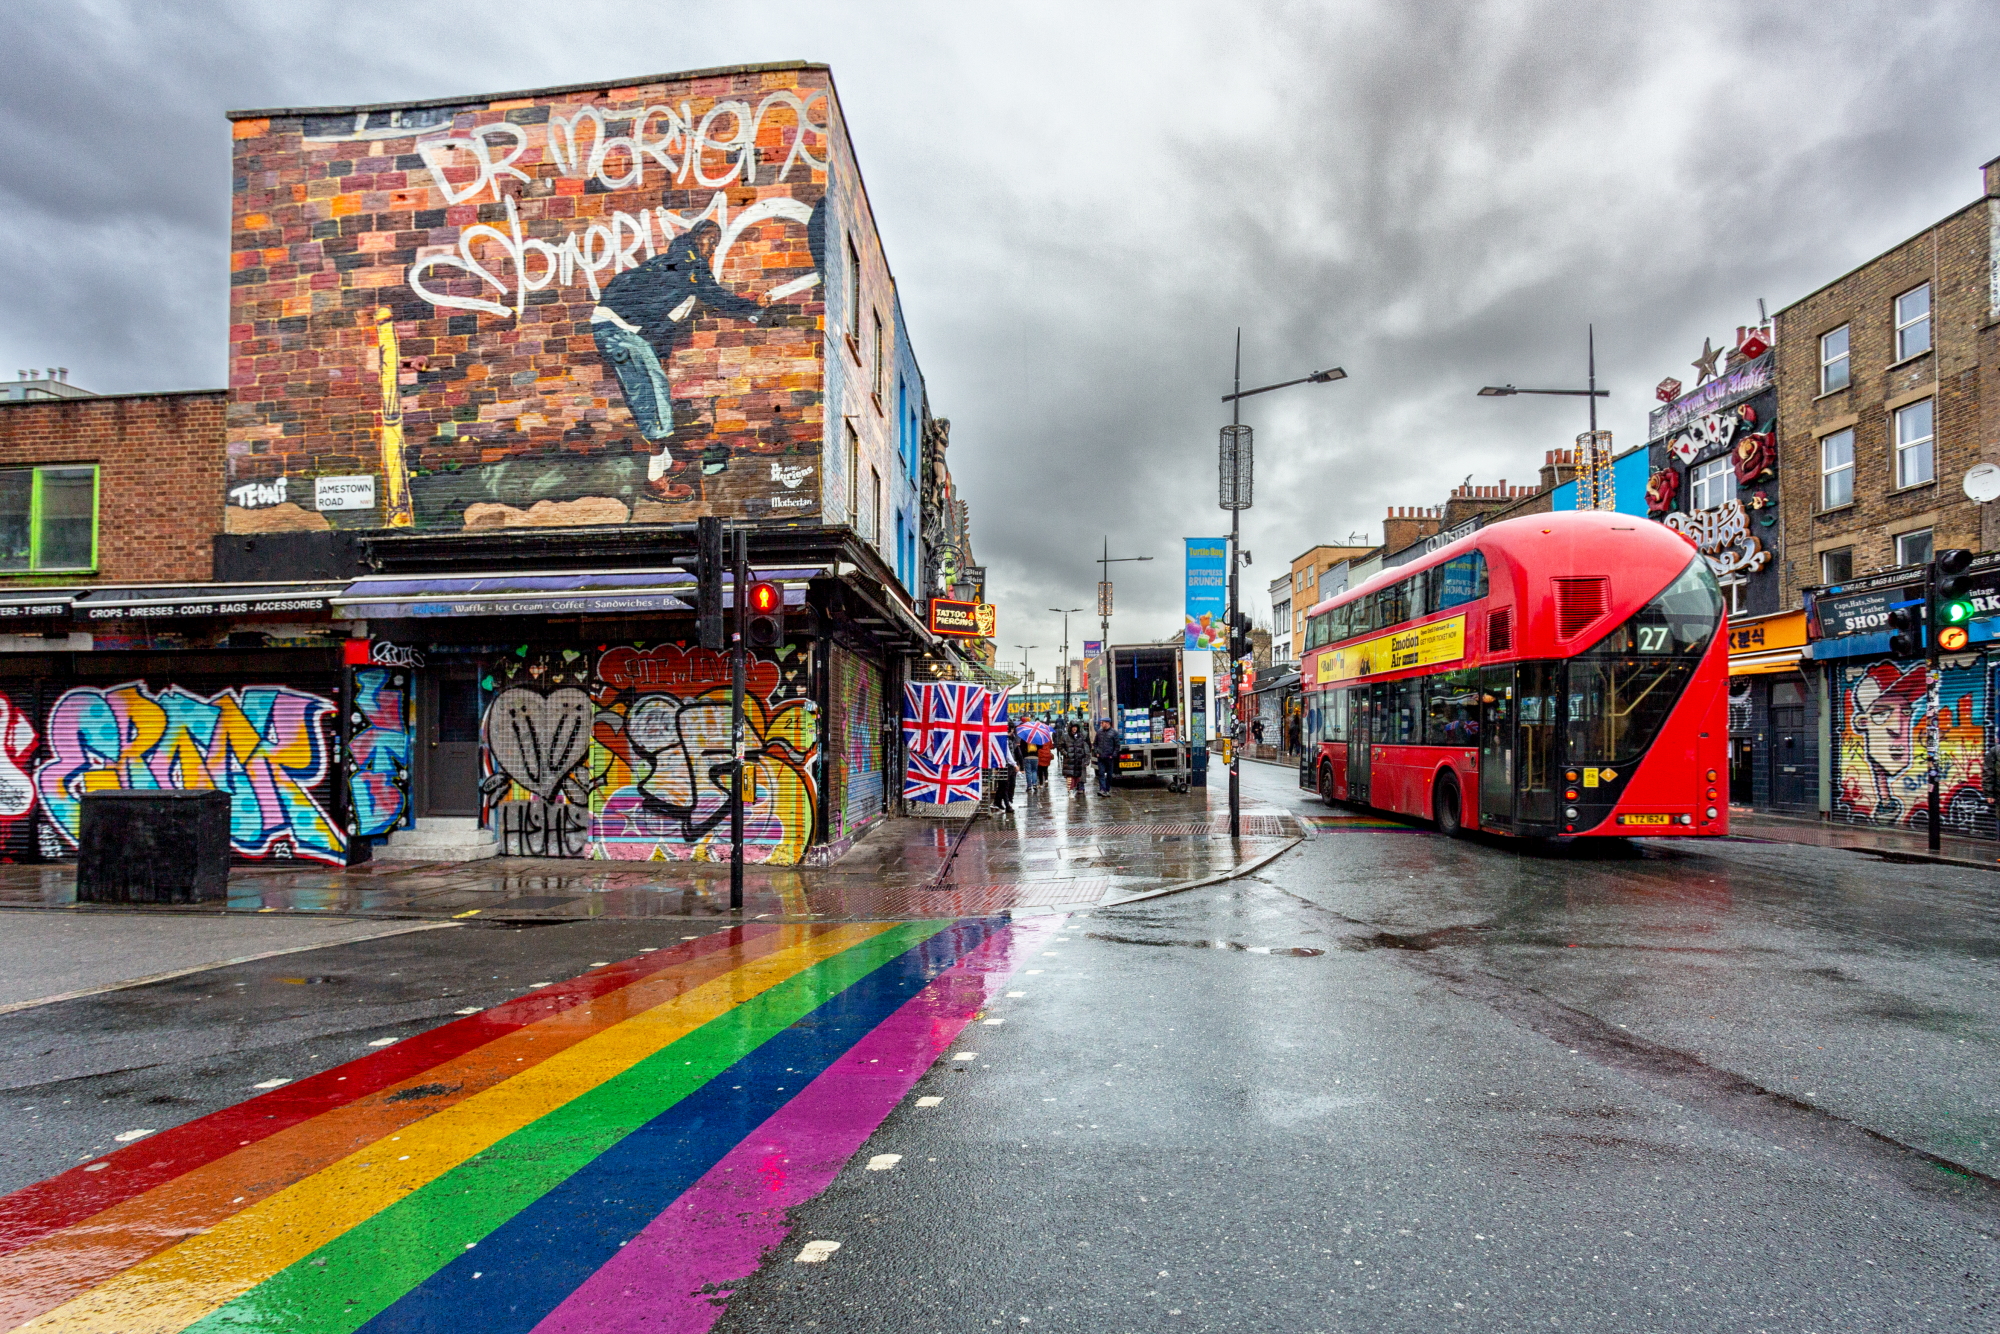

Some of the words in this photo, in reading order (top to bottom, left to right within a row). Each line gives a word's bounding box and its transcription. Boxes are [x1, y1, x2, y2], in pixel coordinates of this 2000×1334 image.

[1706, 379, 1726, 401] The
[318, 484, 372, 494] JAMESTOWN
[318, 497, 344, 507] ROAD
[1189, 547, 1209, 556] Turtle
[1210, 547, 1224, 558] Bay
[1969, 556, 1991, 566] SSES
[1188, 576, 1223, 586] BRUNCH!
[1871, 576, 1887, 586] BAGS
[1893, 570, 1921, 583] LUGGAGE
[1969, 587, 1995, 597] intage
[89, 608, 123, 618] CROPS
[130, 606, 174, 617] DRESSES
[180, 604, 213, 615] COATS
[220, 603, 248, 613] BAGS
[254, 599, 323, 612] ACCESSORIES
[455, 604, 486, 613] Waffle
[495, 603, 510, 612] Ice
[512, 602, 543, 612] Cream
[552, 601, 585, 610] Coffee
[594, 598, 653, 608] Sandwiches
[1970, 594, 2000, 613] RK
[32, 605, 63, 615] SHIRTS
[936, 609, 967, 618] TATTOO
[968, 611, 975, 620] &
[1838, 609, 1855, 618] Jeans
[1860, 604, 1885, 616] Leather
[936, 617, 974, 626] PIERCING
[1845, 611, 1891, 630] SHOP
[1436, 633, 1448, 642] TICKET
[1640, 627, 1669, 650] 27
[1391, 634, 1420, 653] Emotion
[1391, 653, 1402, 668] Air
[1628, 815, 1645, 823] LTZ
[1646, 815, 1665, 823] 1624
